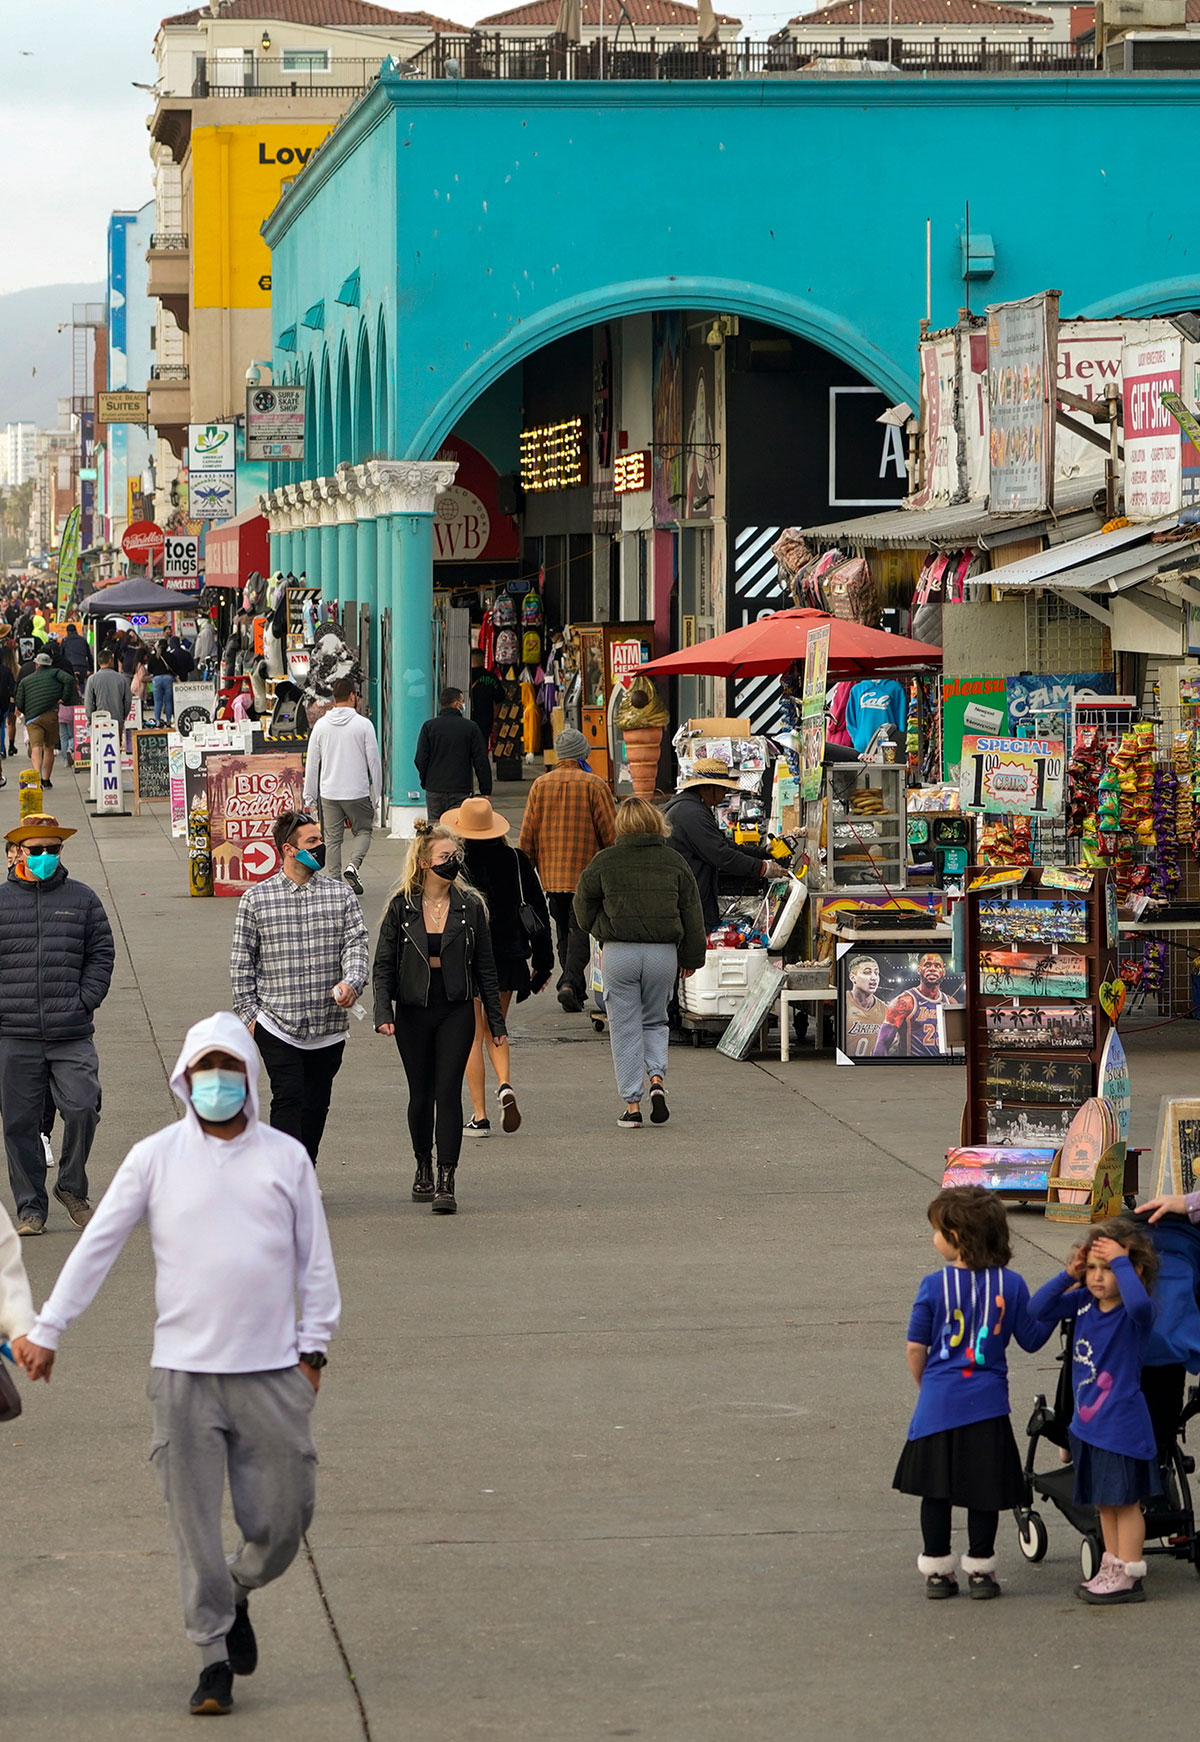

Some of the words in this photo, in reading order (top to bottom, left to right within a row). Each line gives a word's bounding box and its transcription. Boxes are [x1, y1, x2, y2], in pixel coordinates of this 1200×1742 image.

[259, 142, 312, 164] Lov
[106, 402, 140, 410] SUITES
[1131, 382, 1150, 430] GIFT
[165, 539, 196, 558] toe
[166, 560, 196, 575] rings
[166, 579, 196, 589] ANKLETS
[614, 645, 638, 664] ATM
[943, 678, 1007, 702] pleasu
[860, 692, 890, 709] Cal
[977, 738, 1052, 755] SPECIAL
[103, 744, 118, 790] ATM
[238, 775, 277, 793] BIG
[994, 774, 1028, 792] CHIPS
[226, 791, 293, 817] Daddy's
[227, 820, 274, 838] PIZZ
[855, 1038, 869, 1056] 0
